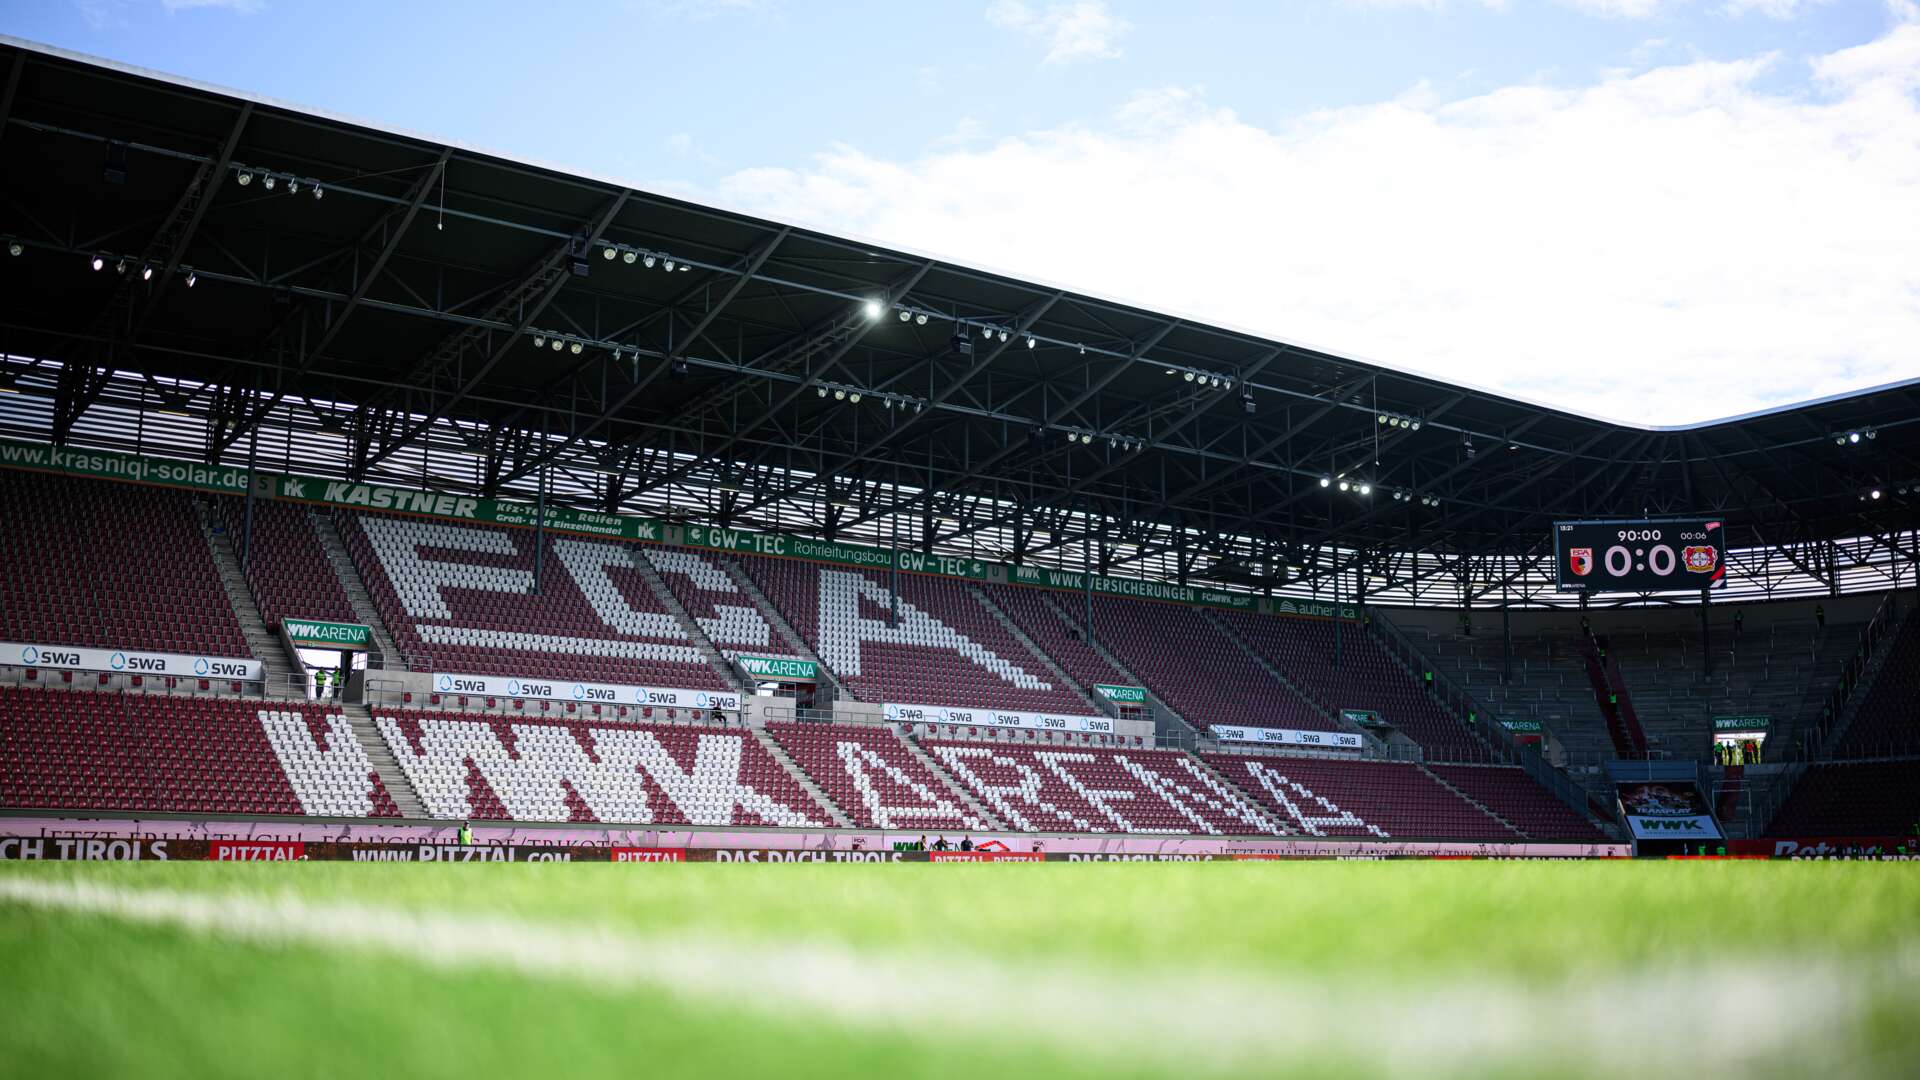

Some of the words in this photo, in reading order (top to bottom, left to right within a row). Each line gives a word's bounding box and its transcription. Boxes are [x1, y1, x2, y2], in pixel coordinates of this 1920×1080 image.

[323, 482, 479, 518] KASTNER
[496, 503, 558, 518] Kfz-Tele
[578, 513, 622, 526] Reifen
[530, 518, 550, 527] ud
[553, 521, 622, 535] Einzelhandel
[1617, 529, 1662, 542] 90:00
[1680, 532, 1707, 540] 00:06
[794, 541, 892, 564] Rohrleitungsbau
[1604, 544, 1676, 577] 0:0
[1016, 566, 1041, 579] WWK
[1049, 571, 1083, 588] WWK
[41, 651, 80, 666] swa
[128, 657, 165, 671] swa
[211, 663, 247, 676] swa
[454, 678, 486, 692] swa
[522, 683, 552, 696] swa
[586, 688, 616, 700] swa
[648, 692, 677, 704] swa
[708, 696, 736, 708] swa
[899, 708, 923, 720] swa
[950, 712, 972, 723] swa
[1000, 715, 1020, 726] swa
[1044, 717, 1066, 728] swa
[1089, 720, 1110, 731] swa
[1225, 729, 1244, 739] swa
[1265, 731, 1283, 741] swa
[1302, 734, 1320, 744] swa
[1339, 736, 1356, 746] swa
[1640, 819, 1703, 829] WWK
